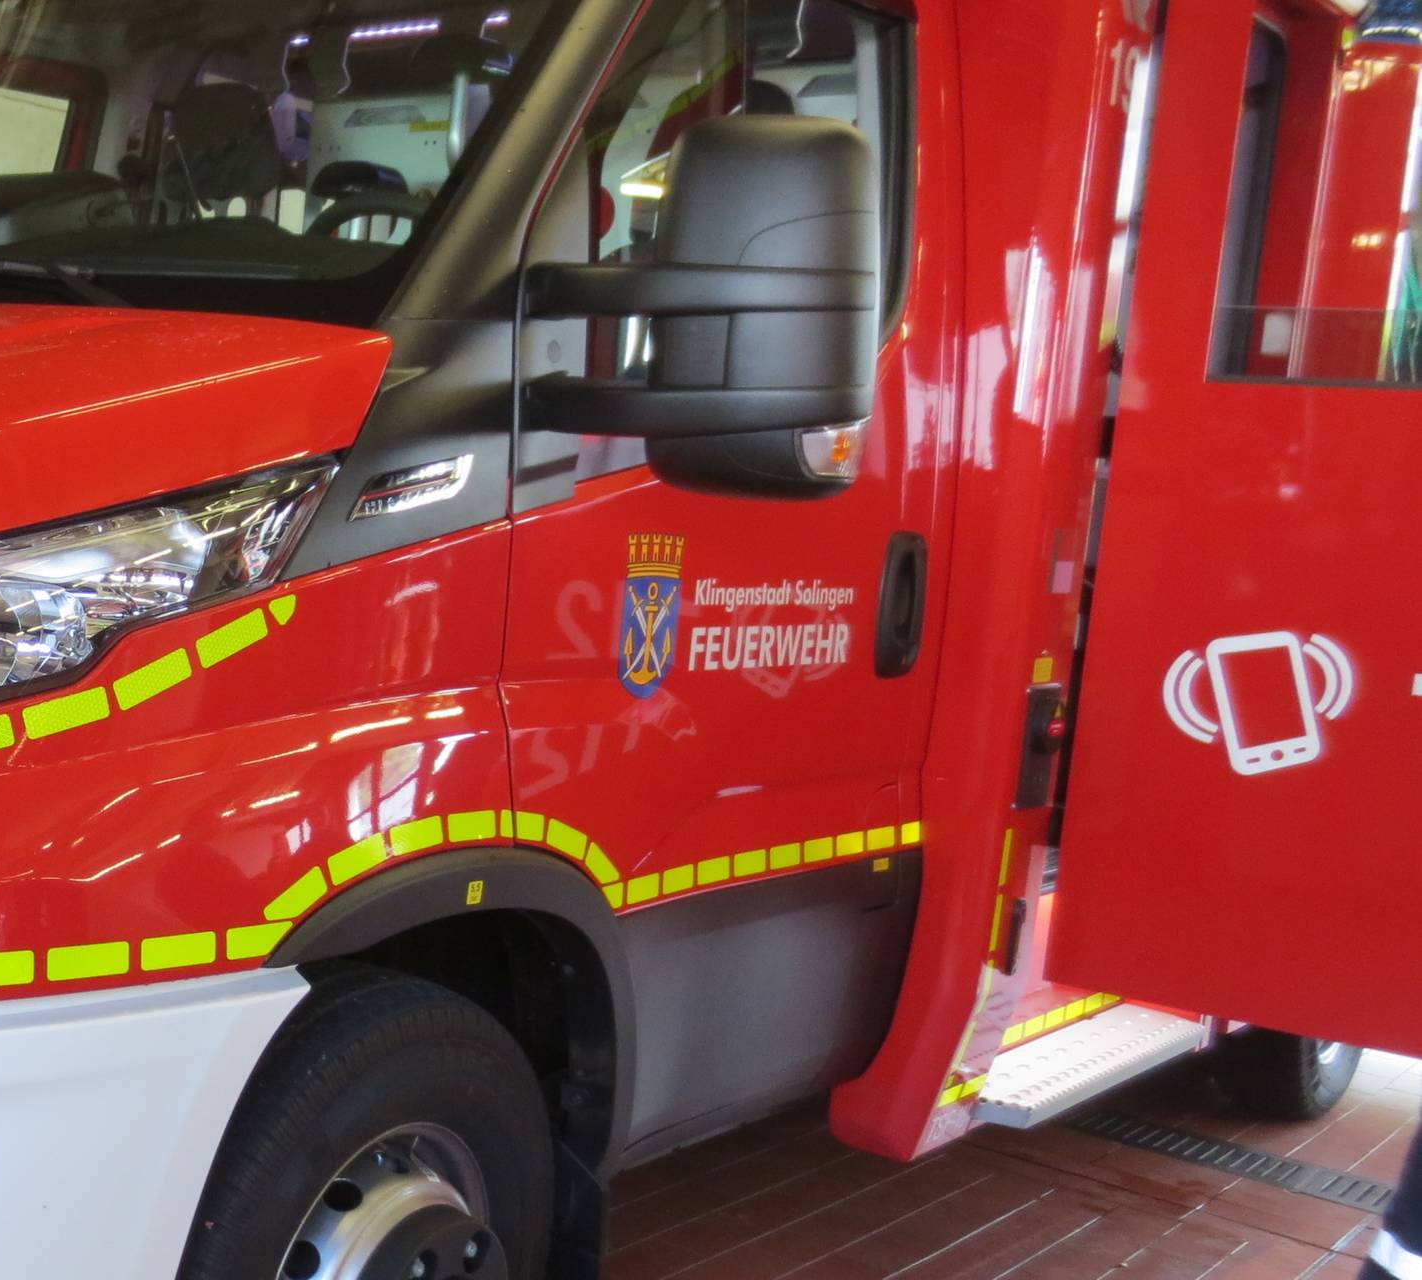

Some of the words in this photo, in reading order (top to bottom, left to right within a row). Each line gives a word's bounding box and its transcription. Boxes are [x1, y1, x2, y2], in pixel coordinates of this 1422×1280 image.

[694, 577, 791, 612] Klingenstadt
[793, 579, 854, 612] Solingen
[687, 623, 850, 671] FEUERWEHR
